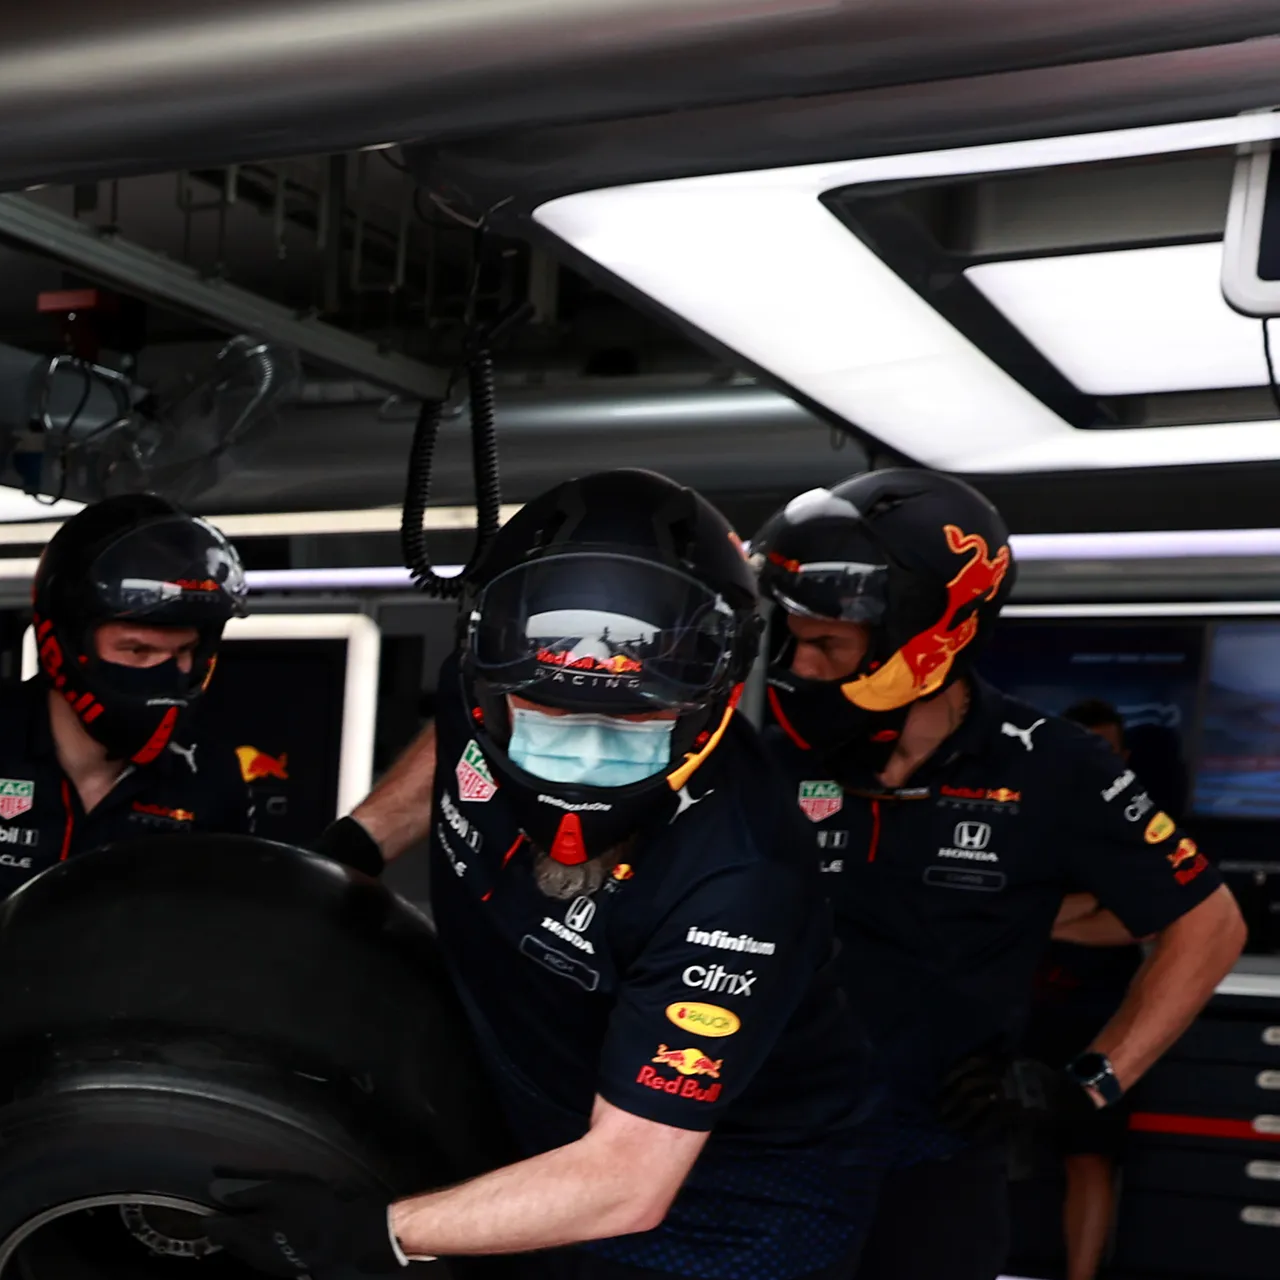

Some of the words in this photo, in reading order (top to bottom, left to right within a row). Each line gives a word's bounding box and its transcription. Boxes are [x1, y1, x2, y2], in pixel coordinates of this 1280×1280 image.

[938, 847, 999, 862] HONDA
[686, 926, 776, 956] infinitum
[682, 963, 757, 996] citrix
[635, 1065, 682, 1094] Red
[680, 1077, 723, 1103] Bull
